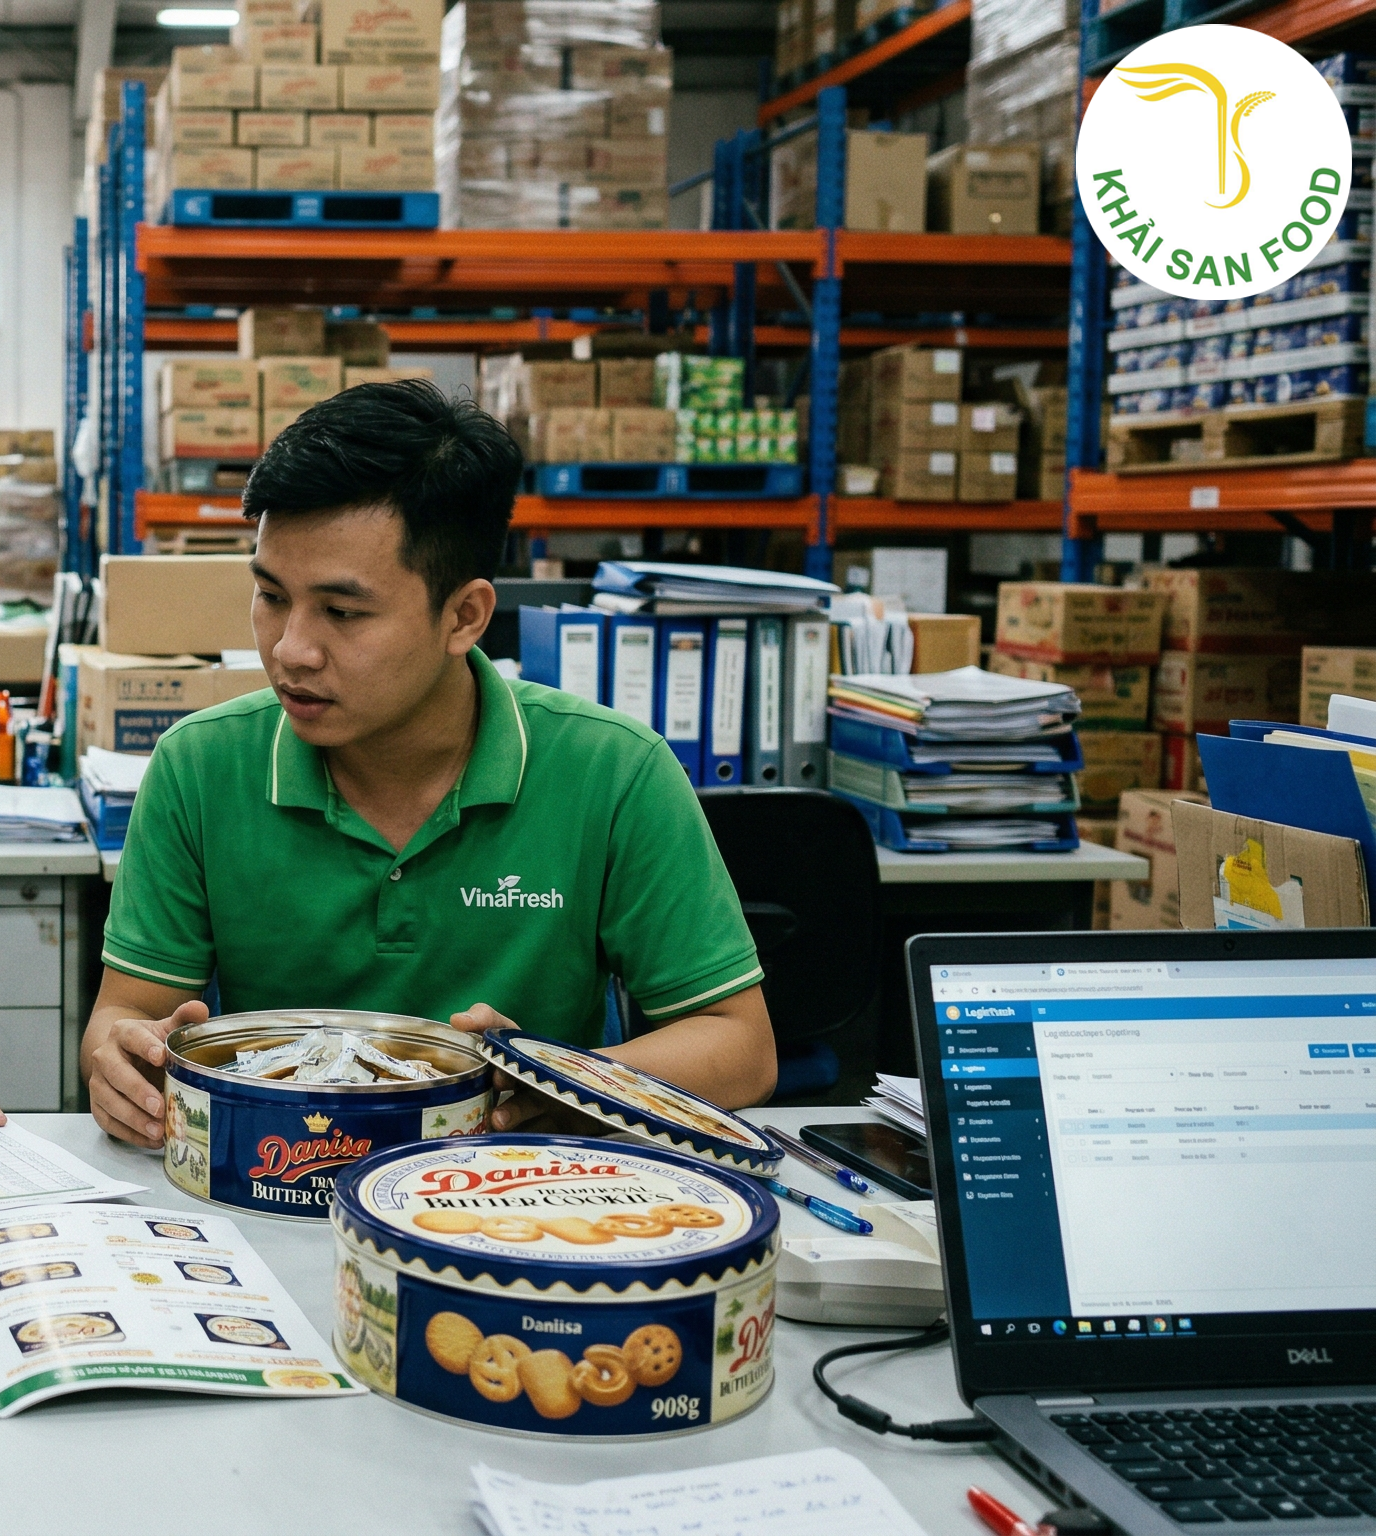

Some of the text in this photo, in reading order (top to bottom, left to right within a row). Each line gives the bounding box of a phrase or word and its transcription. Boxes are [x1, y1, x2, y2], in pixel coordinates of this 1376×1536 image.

[460, 887, 564, 909] VinaFresh
[248, 1128, 372, 1183] Danisa
[414, 1161, 636, 1195] Danisa
[252, 1181, 312, 1205] BUTTER
[423, 1192, 674, 1209] BUTTER COOKIES
[535, 1186, 654, 1195] TRADITIONAL
[1287, 1348, 1333, 1364] DELL
[651, 1394, 700, 1420] 908g
